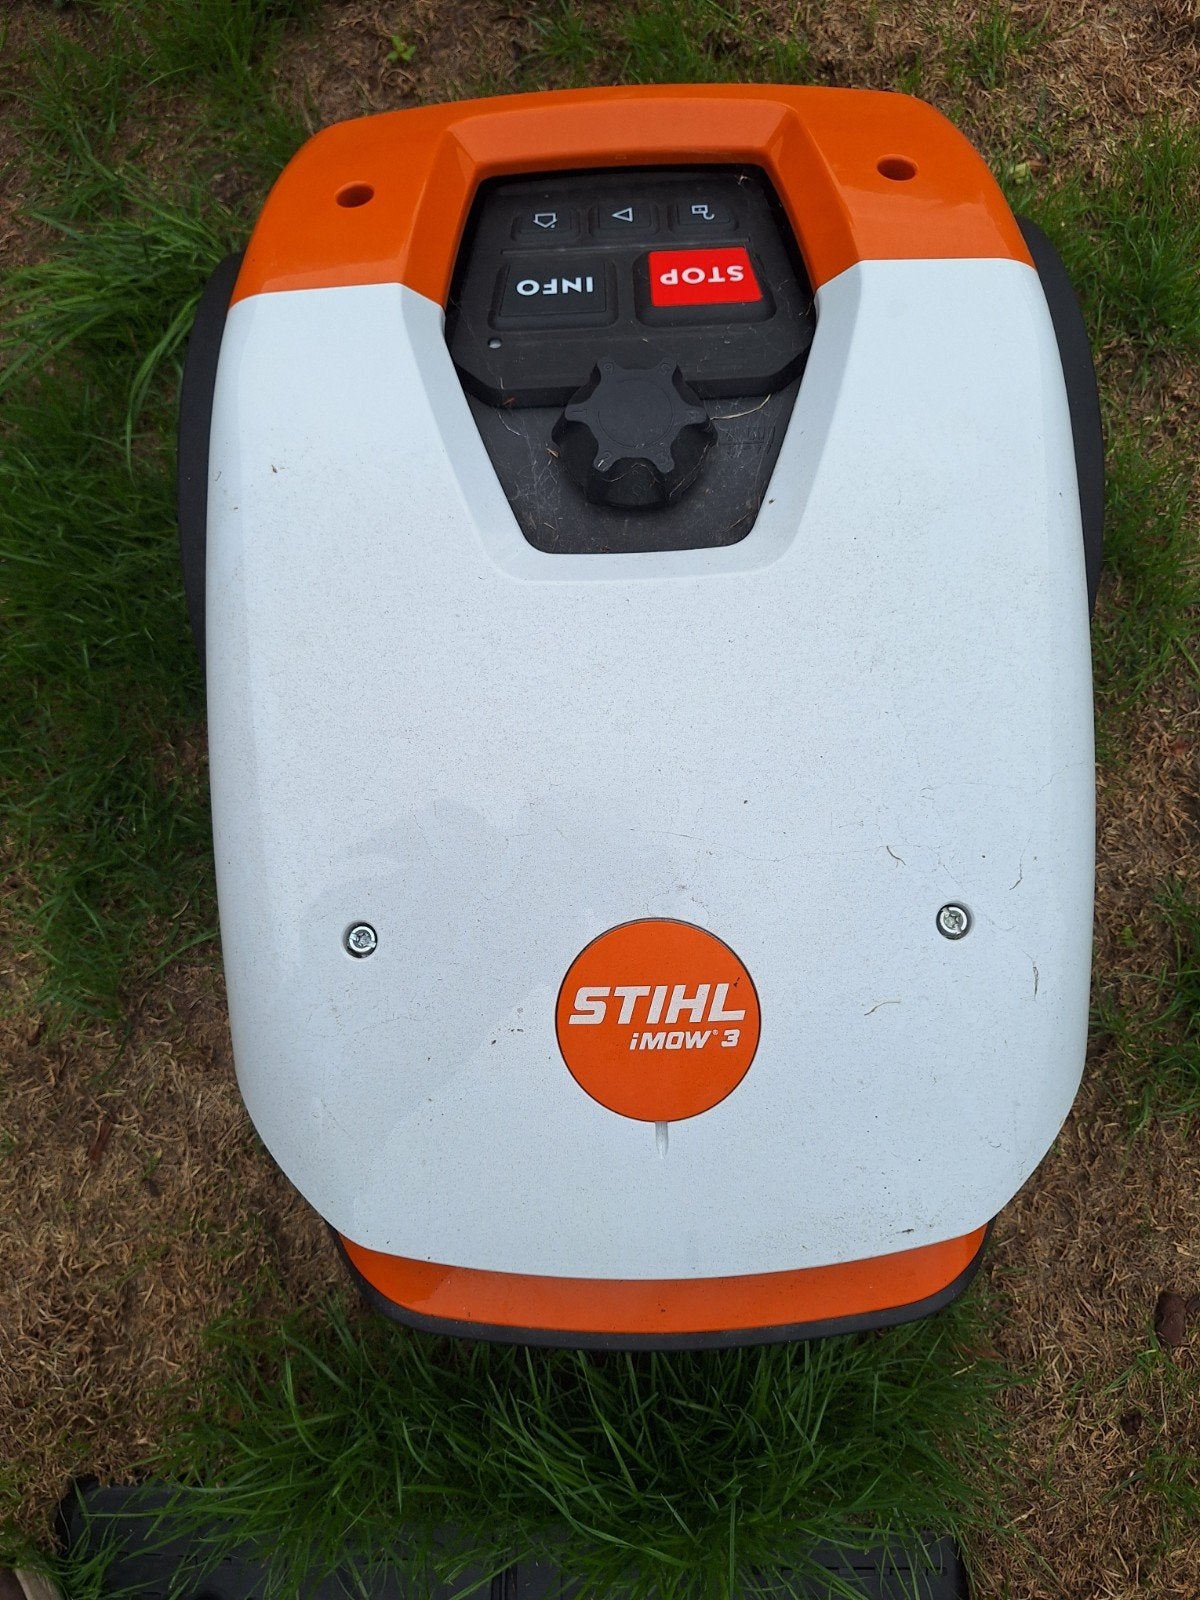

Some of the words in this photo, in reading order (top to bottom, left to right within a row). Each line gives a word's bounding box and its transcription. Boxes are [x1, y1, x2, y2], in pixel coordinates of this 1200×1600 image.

[660, 265, 744, 285] STOP
[516, 276, 594, 296] INFO
[568, 983, 746, 1025] STIHL
[721, 1028, 741, 1048] 3
